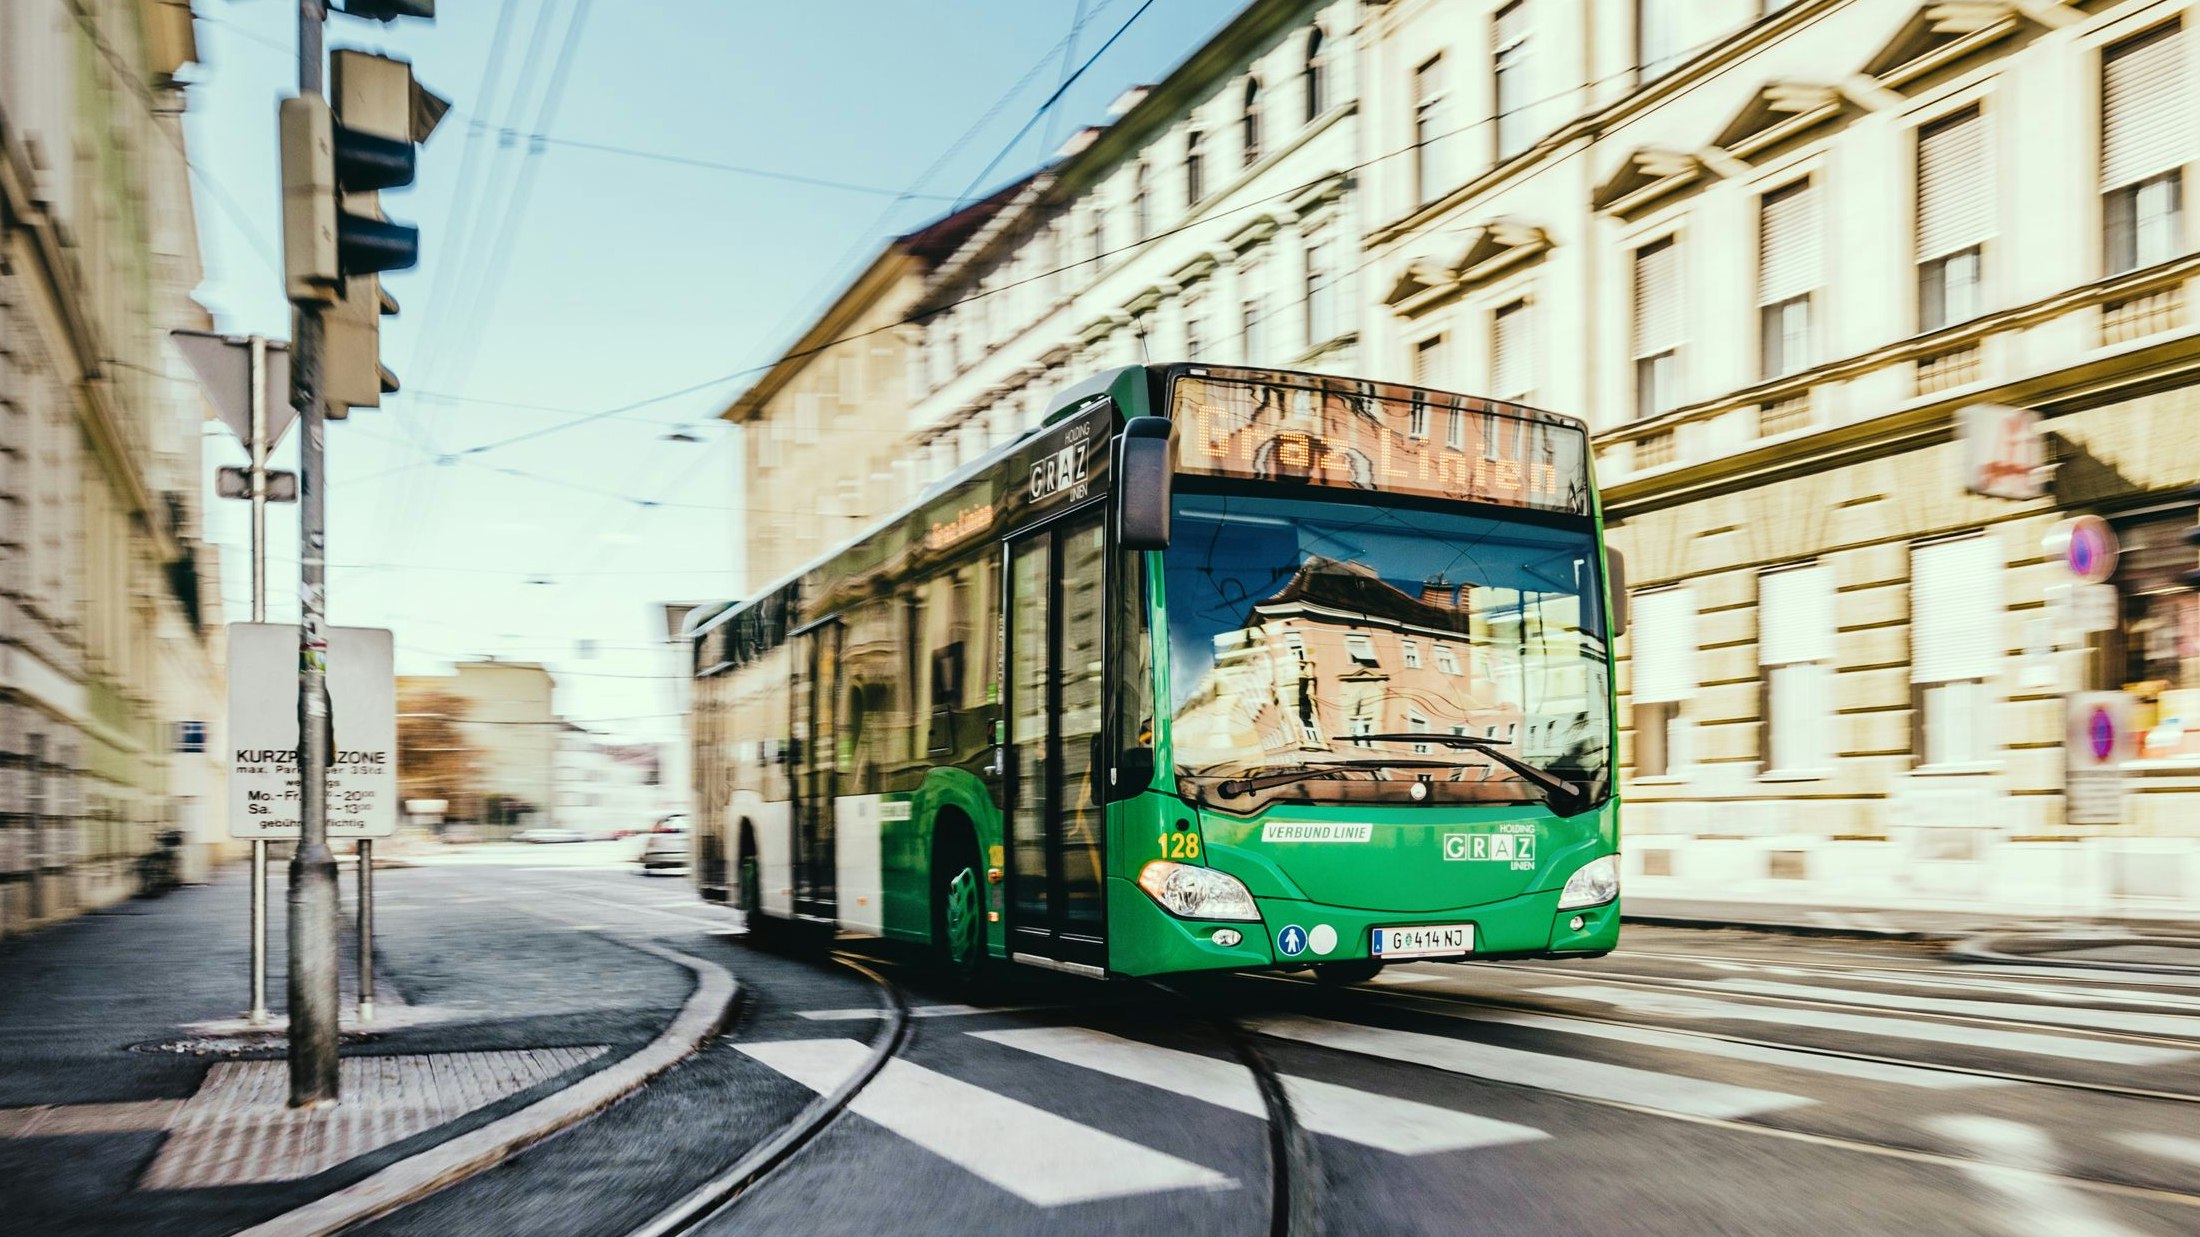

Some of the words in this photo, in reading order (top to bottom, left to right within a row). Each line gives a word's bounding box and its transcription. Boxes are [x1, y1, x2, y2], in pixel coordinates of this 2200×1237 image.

[1199, 405, 1349, 471] Graz
[1381, 428, 1556, 495] Linien
[1030, 443, 1087, 499] GRAZ
[236, 749, 386, 764] KURZPZONE
[247, 803, 272, 815] Sa.
[1268, 826, 1331, 839] VERBUND
[1333, 827, 1366, 839] LINIE
[1500, 824, 1535, 834] HOLDING
[1157, 832, 1200, 859] 128
[1445, 834, 1534, 860] GRAZ
[1510, 861, 1535, 871] LINIEN
[1393, 932, 1402, 950] G
[1414, 931, 1440, 949] 414
[1444, 929, 1463, 948] NJ
